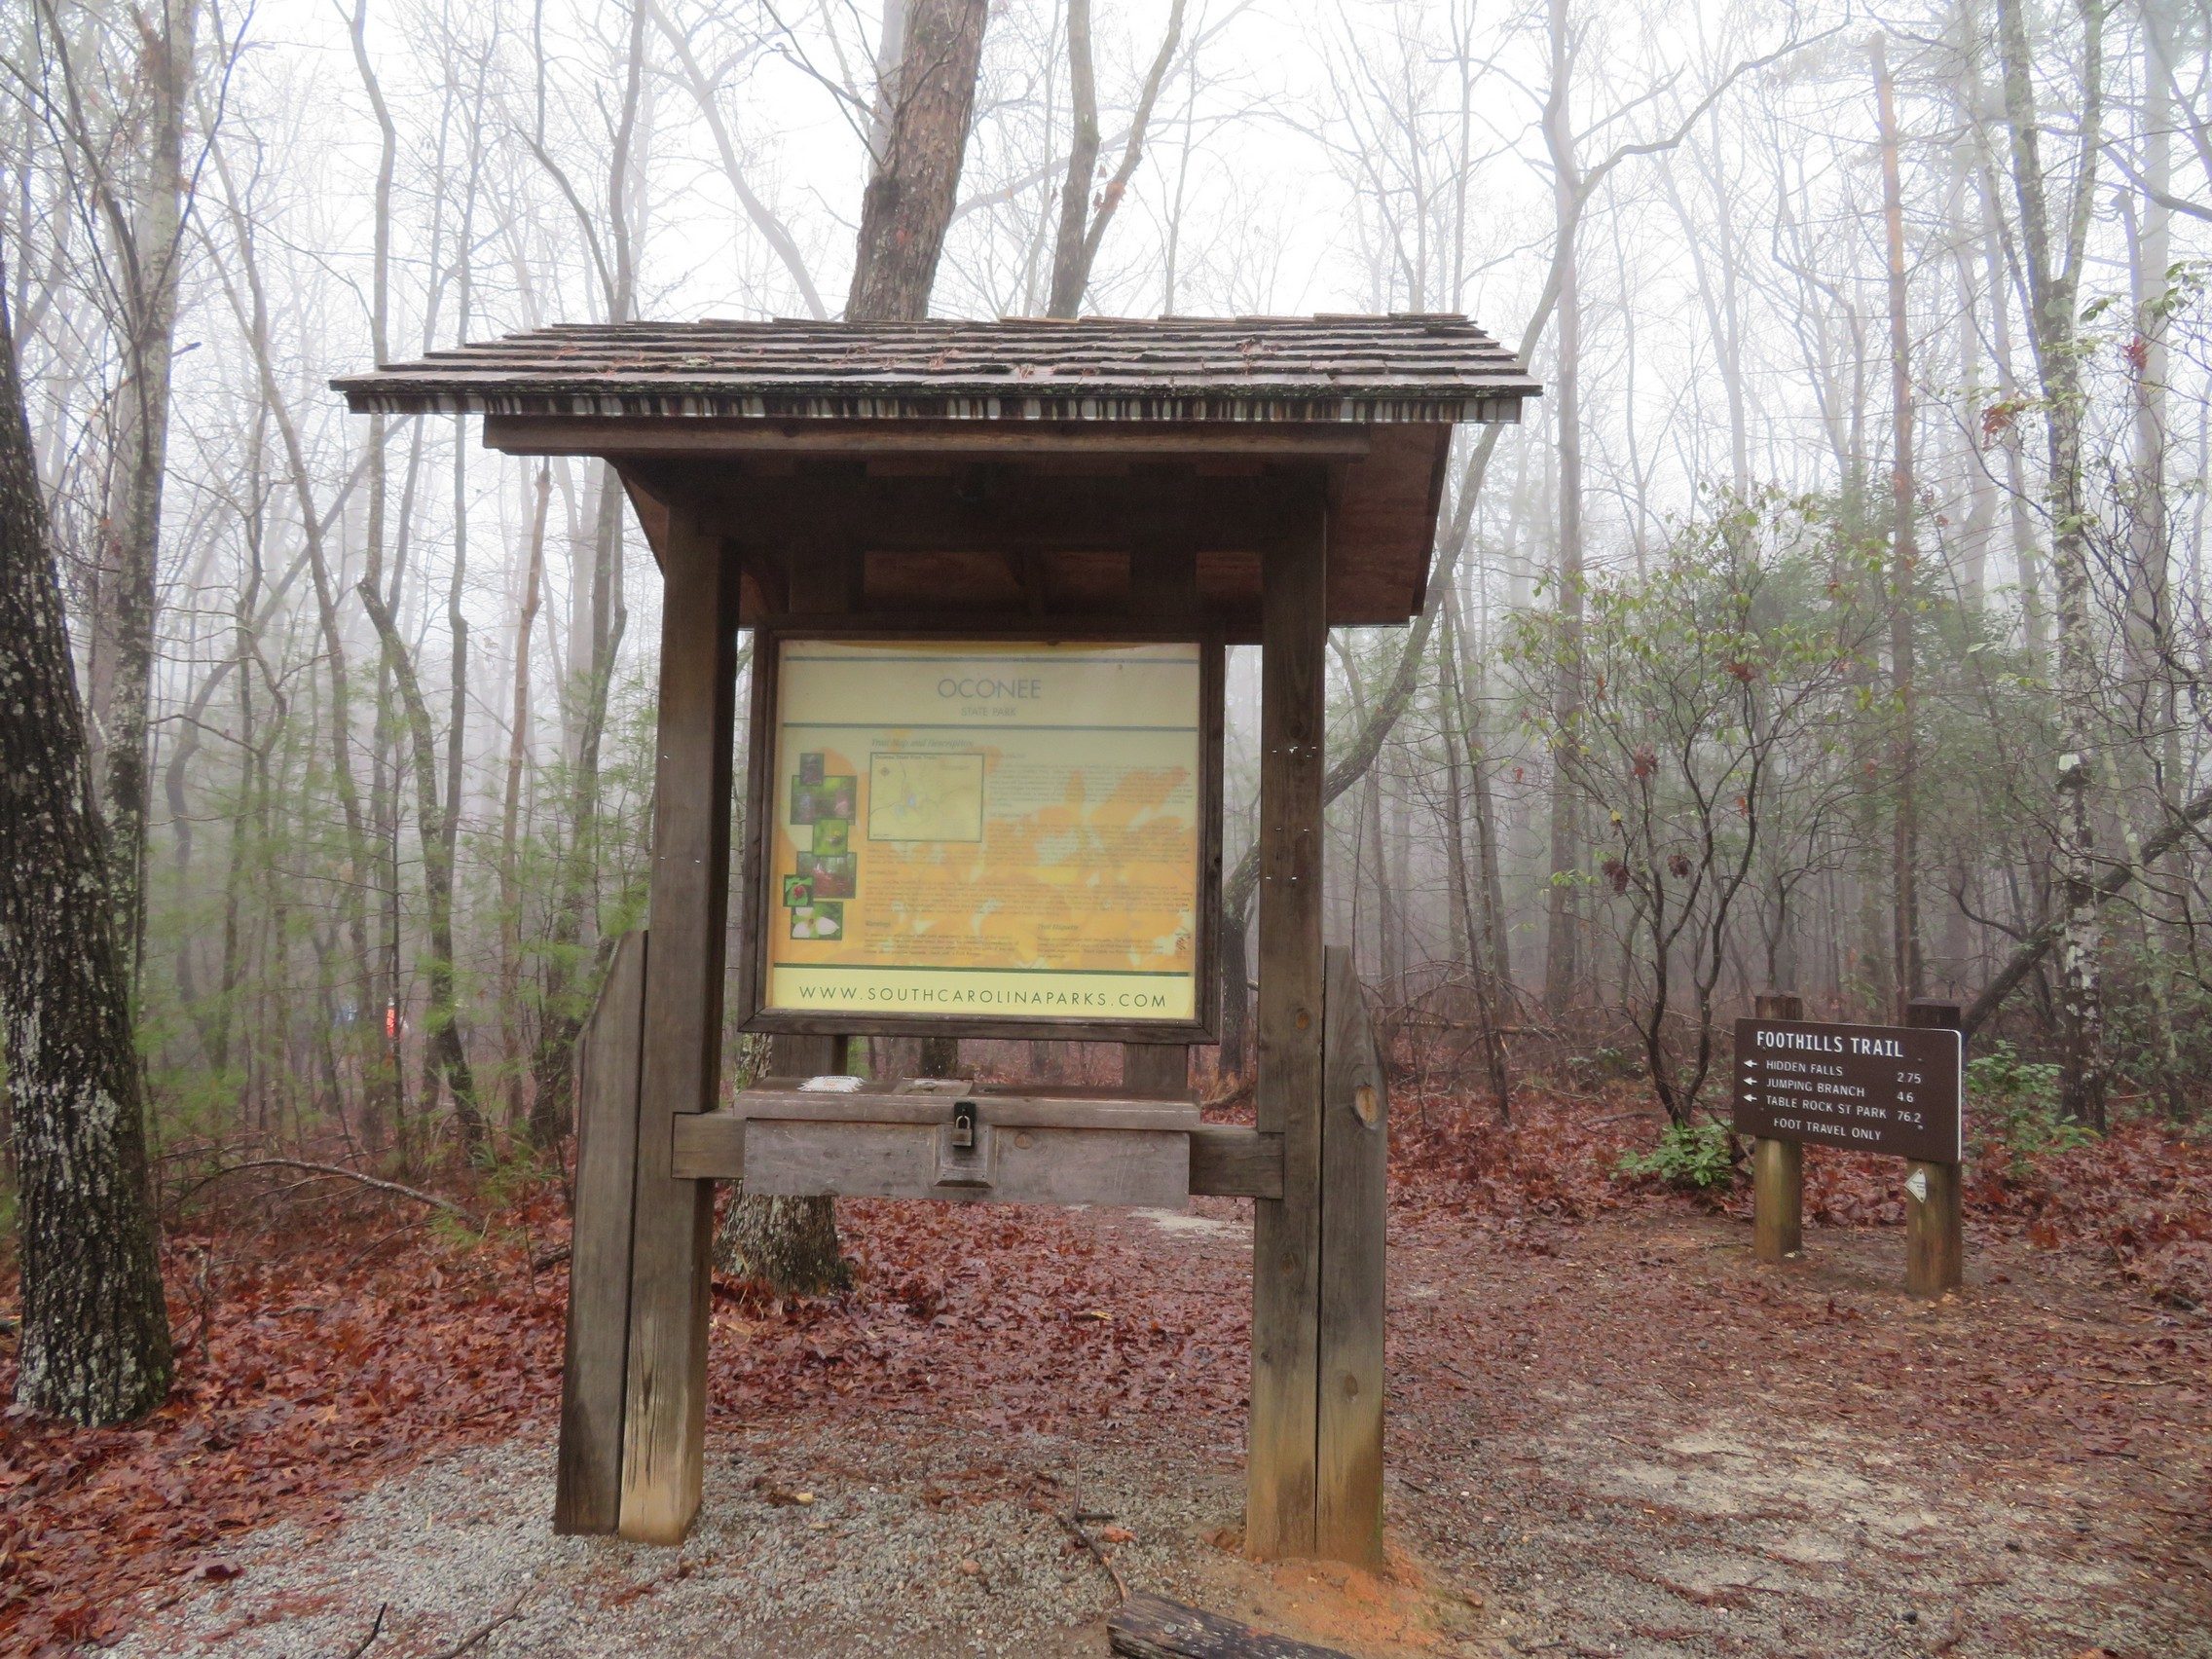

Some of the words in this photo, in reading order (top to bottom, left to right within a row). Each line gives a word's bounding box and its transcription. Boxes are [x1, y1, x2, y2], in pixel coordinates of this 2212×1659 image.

[938, 679, 1042, 699] OCONEE
[961, 707, 988, 717] STATE
[992, 707, 1016, 718] PARK
[799, 986, 1166, 1008] WWW.SOUTHCAROLINAPARKS.COM
[1756, 1031, 1843, 1052] FOOTHILLS
[1851, 1038, 1903, 1057] TRAIL
[1766, 1060, 1806, 1073] HIDDEN
[1811, 1064, 1843, 1076] FALLS
[1766, 1078, 1813, 1092] JUMPING
[1817, 1082, 1865, 1097] BRANCH
[1766, 1095, 1797, 1108] TABLE
[1802, 1099, 1832, 1112] ROCK
[1838, 1104, 1851, 1115] ST
[1857, 1107, 1887, 1119] PARK
[1898, 1110, 1922, 1124] 76.2
[1774, 1118, 1801, 1130] FOOT
[1806, 1122, 1846, 1137] TRAVEL
[1851, 1127, 1881, 1141] ONLY
